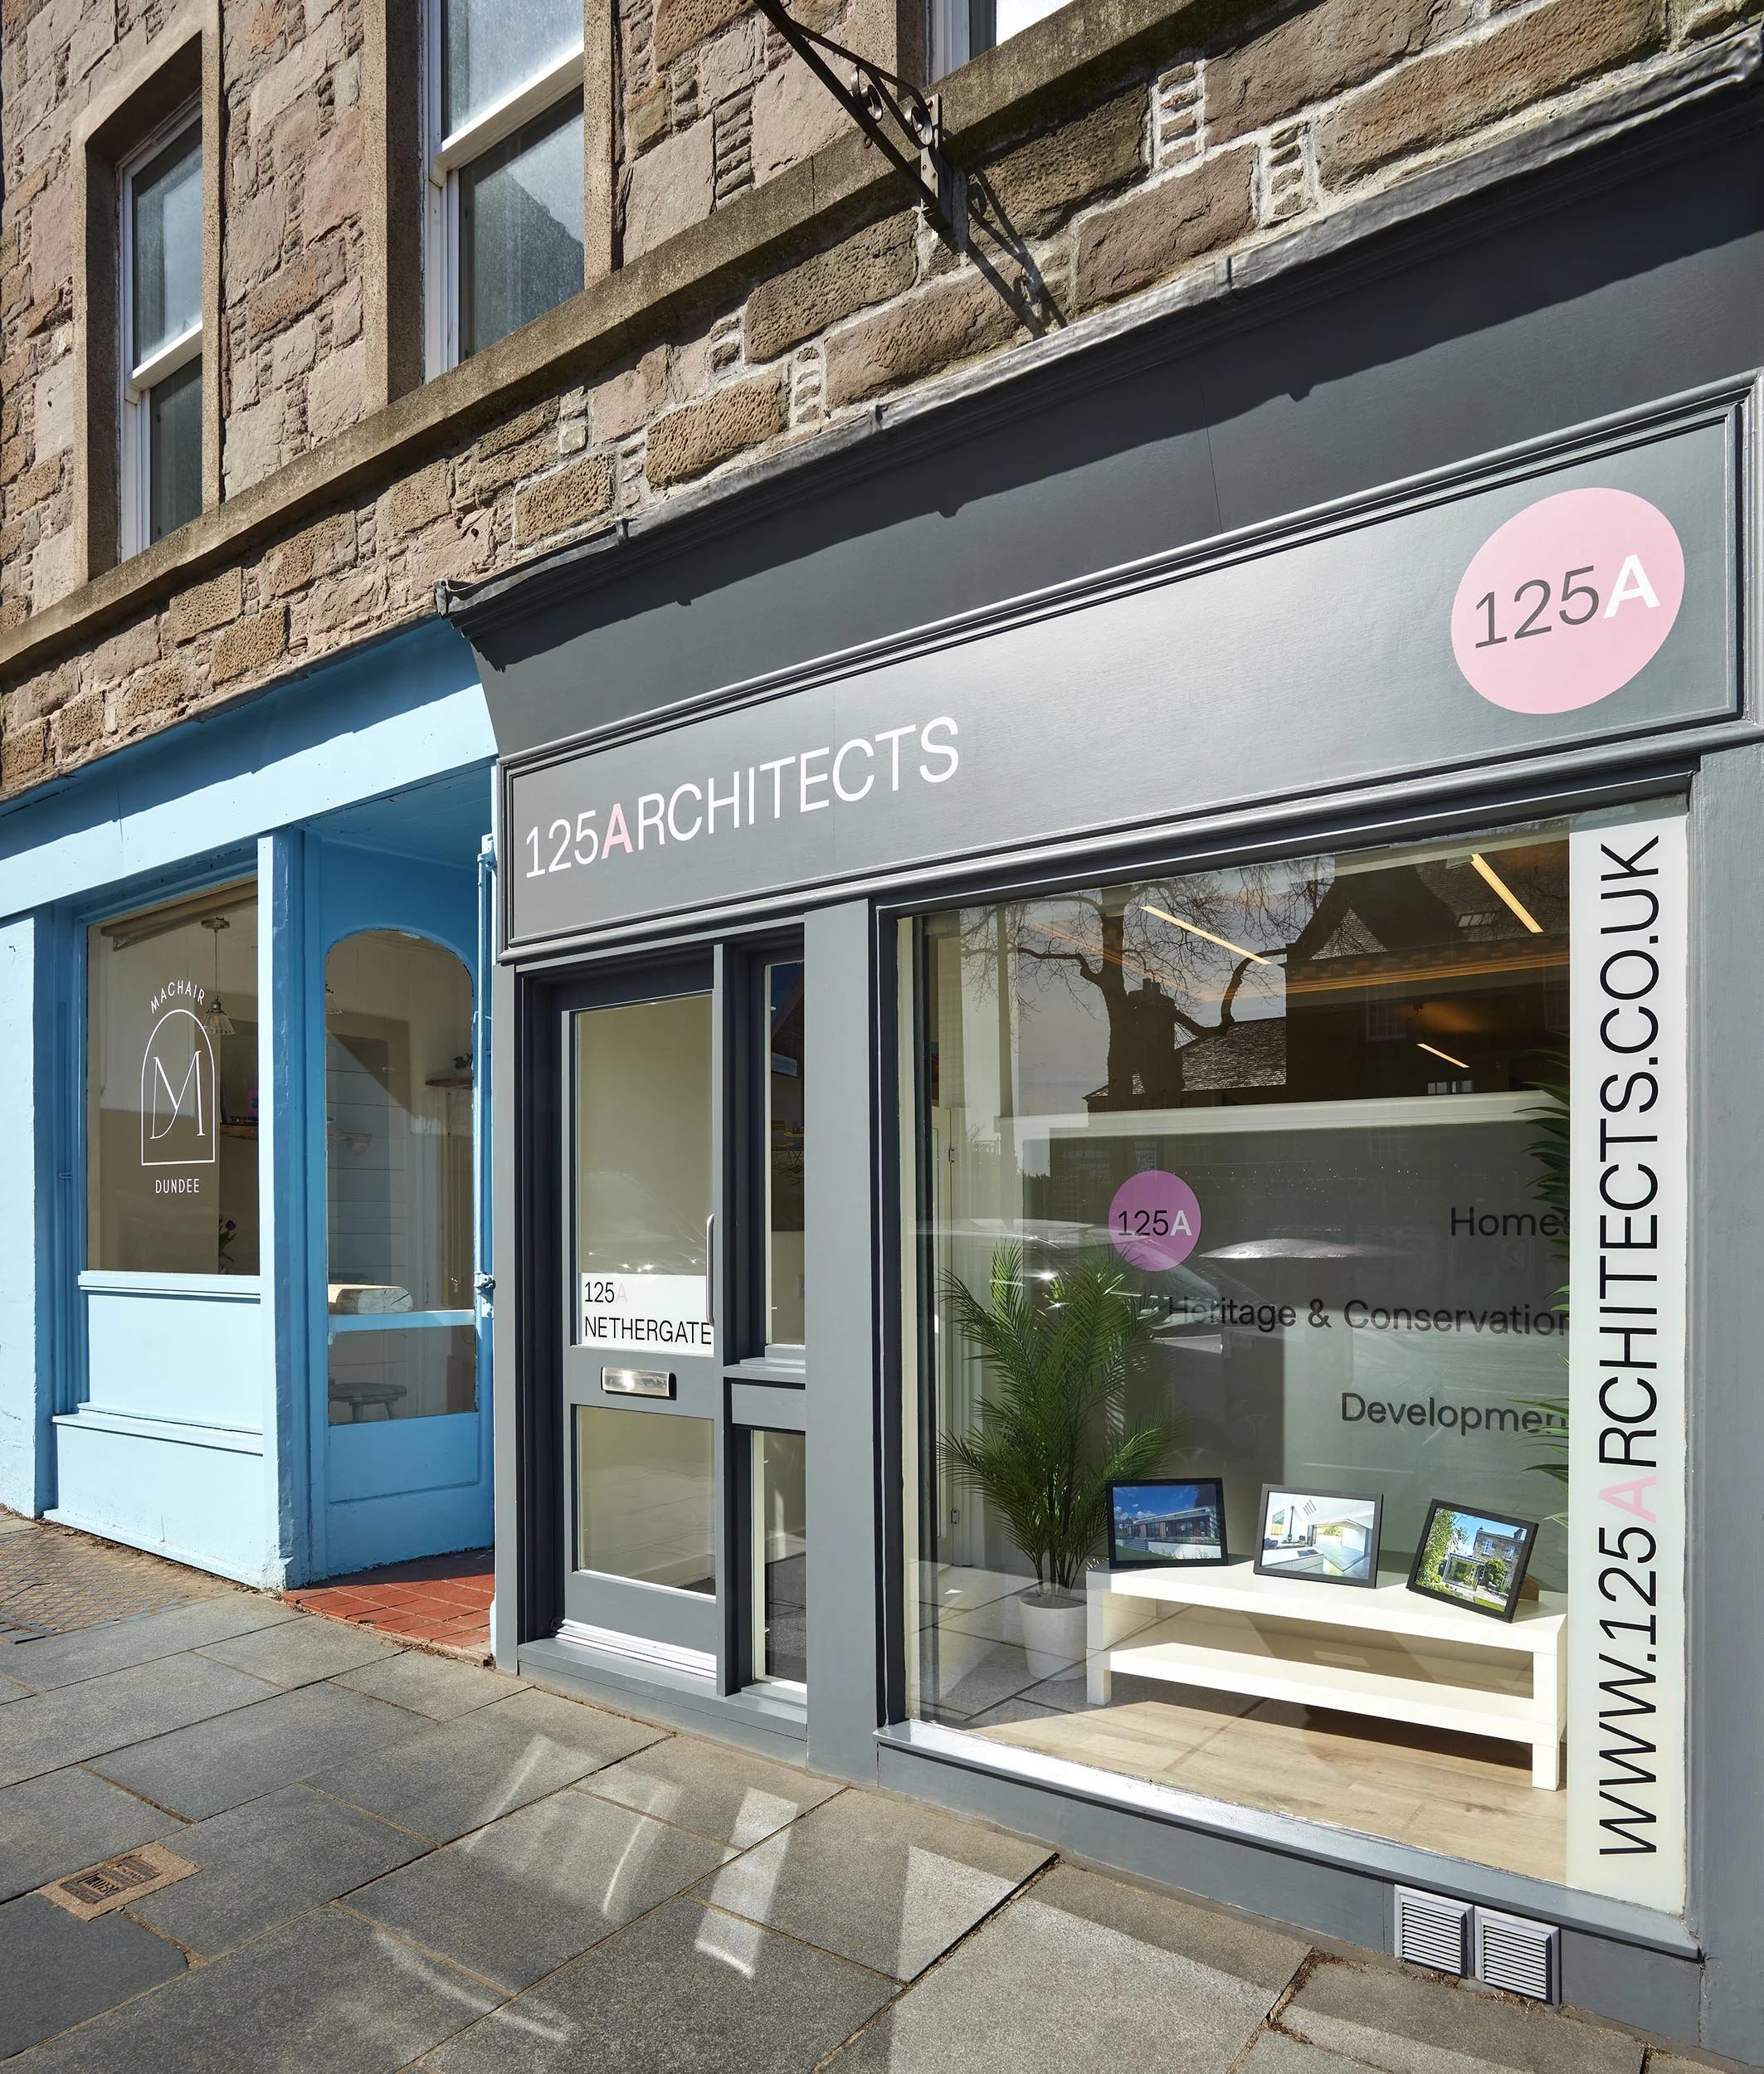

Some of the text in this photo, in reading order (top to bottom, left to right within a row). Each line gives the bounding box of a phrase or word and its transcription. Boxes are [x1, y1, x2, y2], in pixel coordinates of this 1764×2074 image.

[1475, 553, 1660, 649] 125A
[525, 716, 959, 878] 125ARCHITECTS
[150, 980, 205, 1014] MACHAIR
[149, 1050, 206, 1139] M
[155, 1178, 200, 1194] DUNDEE
[1118, 1210, 1192, 1236] 125A
[585, 1282, 628, 1303] 125A
[585, 1316, 712, 1345] NETHERGATE
[1169, 1297, 1296, 1332] Heritage
[1308, 1298, 1332, 1328] &
[1599, 835, 1659, 1855] WWW.125ARCHITECTS.CO.UK
